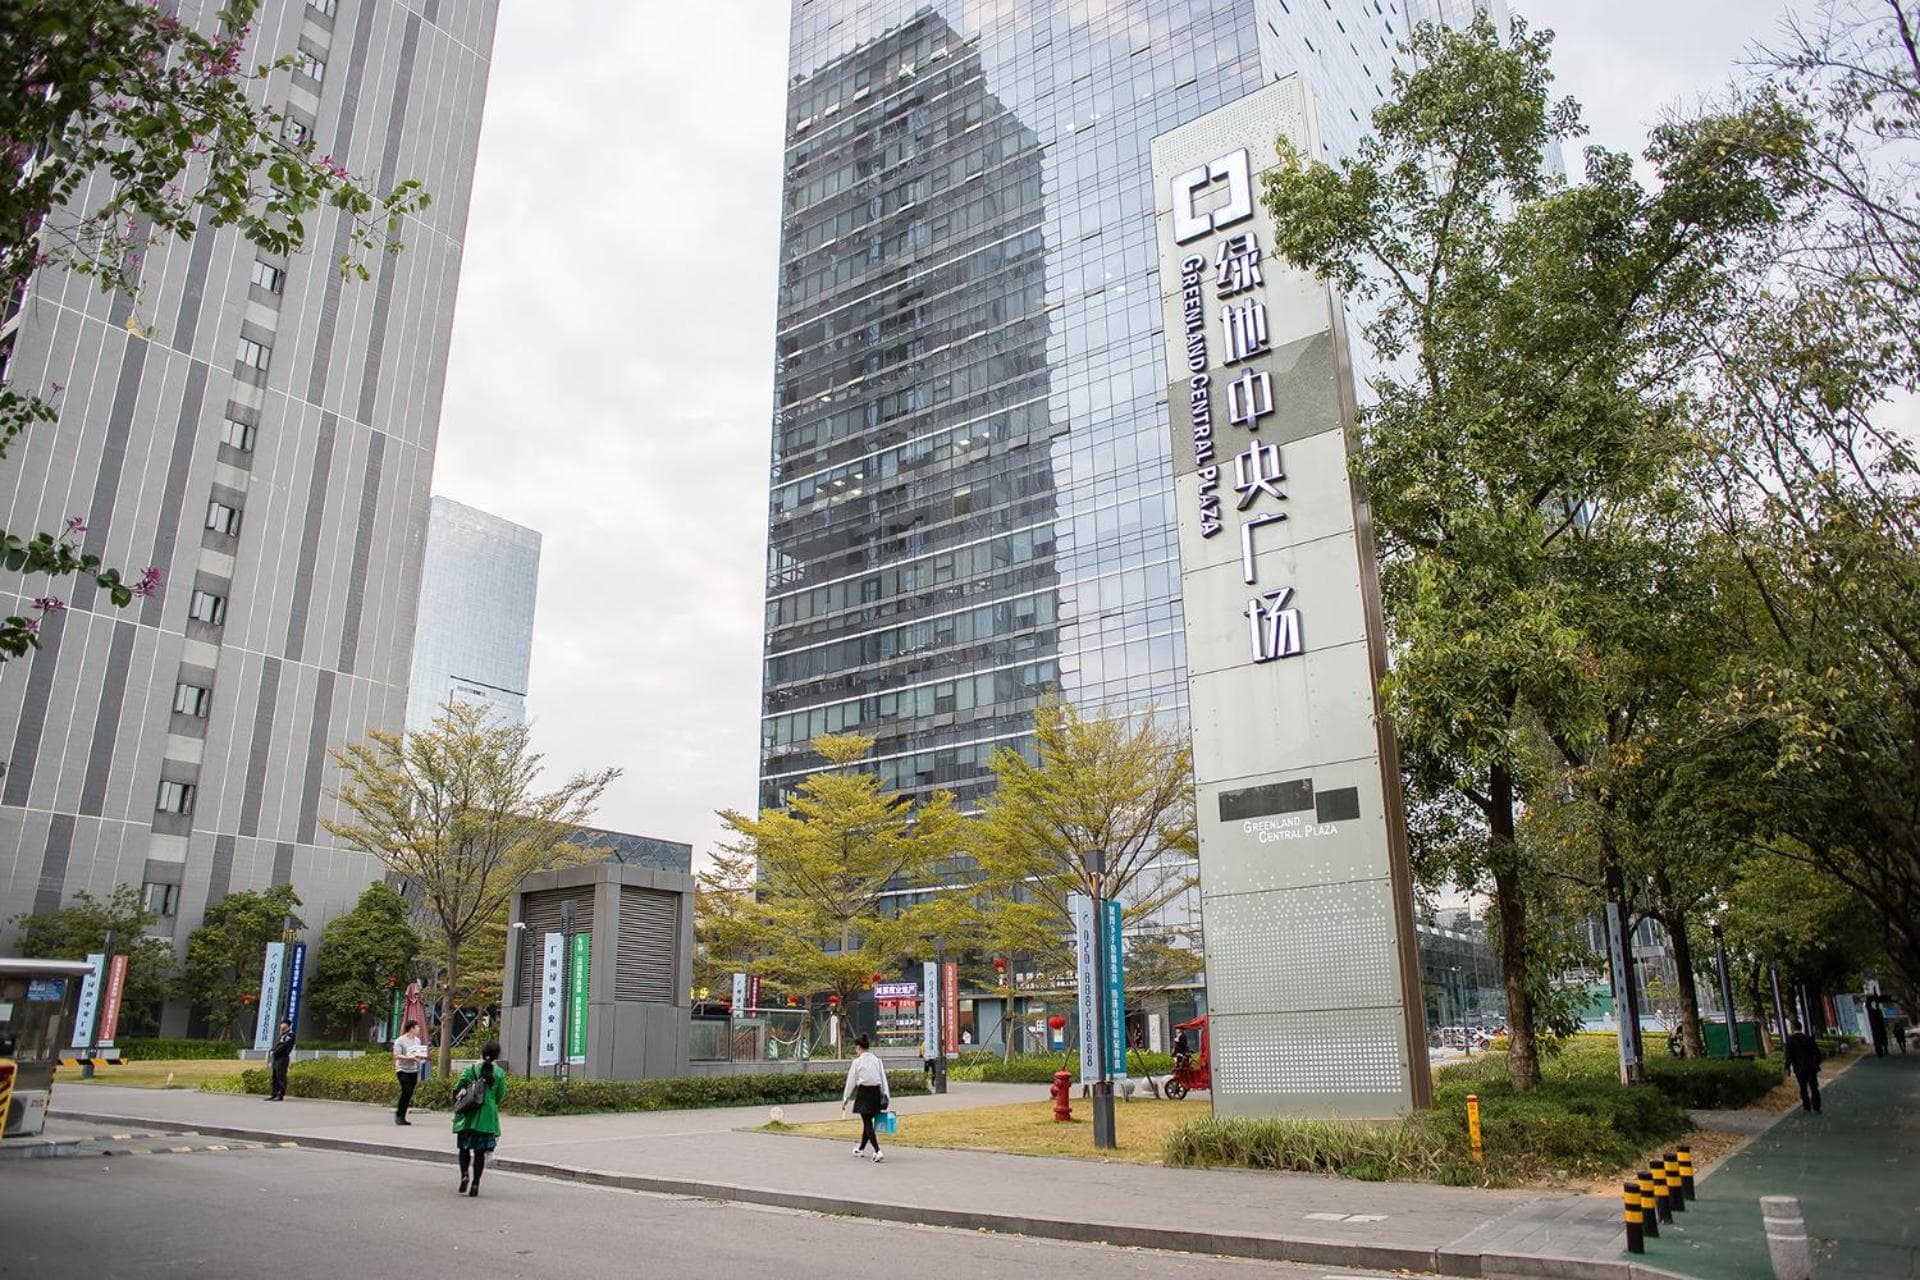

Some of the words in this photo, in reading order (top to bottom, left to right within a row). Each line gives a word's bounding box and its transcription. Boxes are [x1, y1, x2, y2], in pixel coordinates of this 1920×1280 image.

[1180, 253, 1210, 373] GREENLAND
[1189, 374, 1215, 466] CENTRAL
[1215, 231, 1303, 663] 绿地中央广场
[1197, 465, 1223, 539] PLAZA
[1243, 816, 1300, 834] GREENLAND
[1258, 829, 1304, 844] CENTRAL
[1304, 824, 1338, 838] PLAZA
